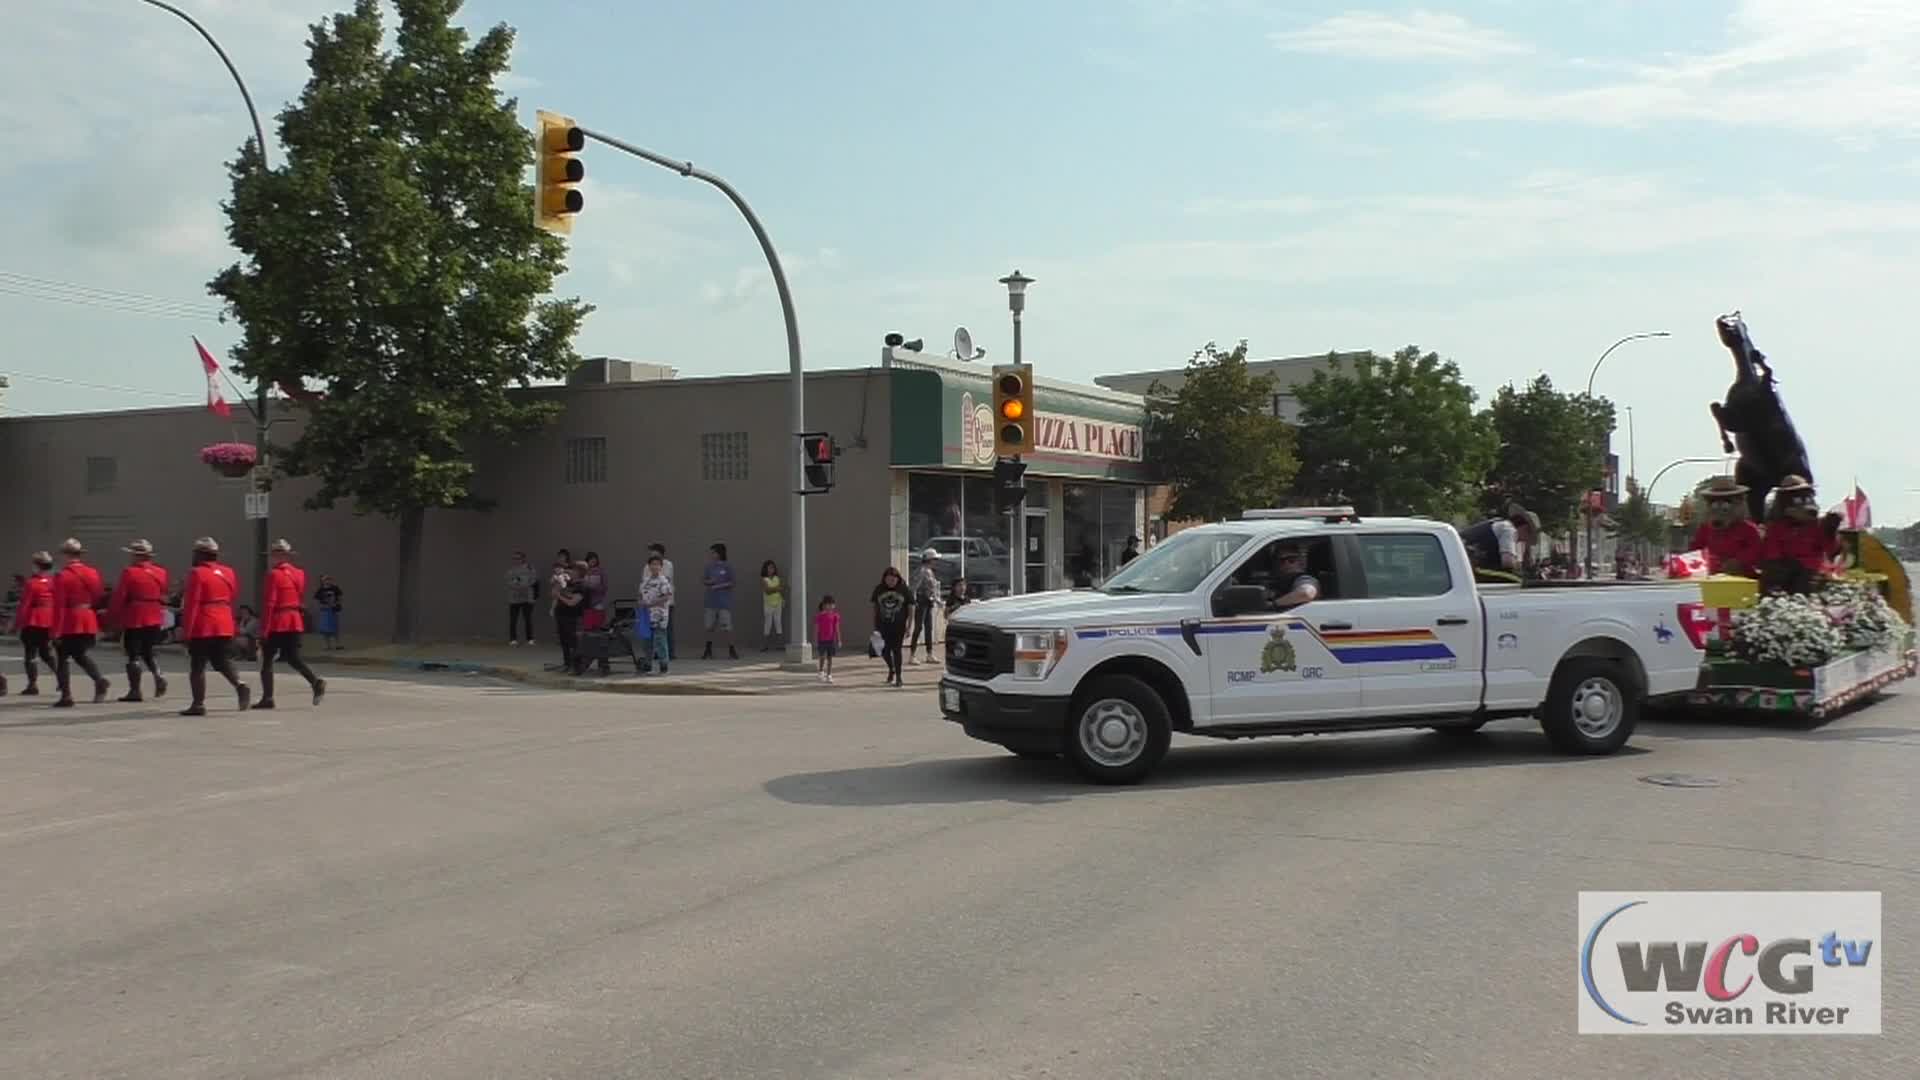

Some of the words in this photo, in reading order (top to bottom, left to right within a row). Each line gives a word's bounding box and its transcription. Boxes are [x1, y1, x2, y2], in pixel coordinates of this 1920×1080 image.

[1034, 417, 1079, 449] IZZA
[1085, 423, 1140, 458] PLACE
[1106, 627, 1157, 638] POLICE
[1227, 670, 1256, 683] RCMP
[1302, 666, 1324, 680] GRC
